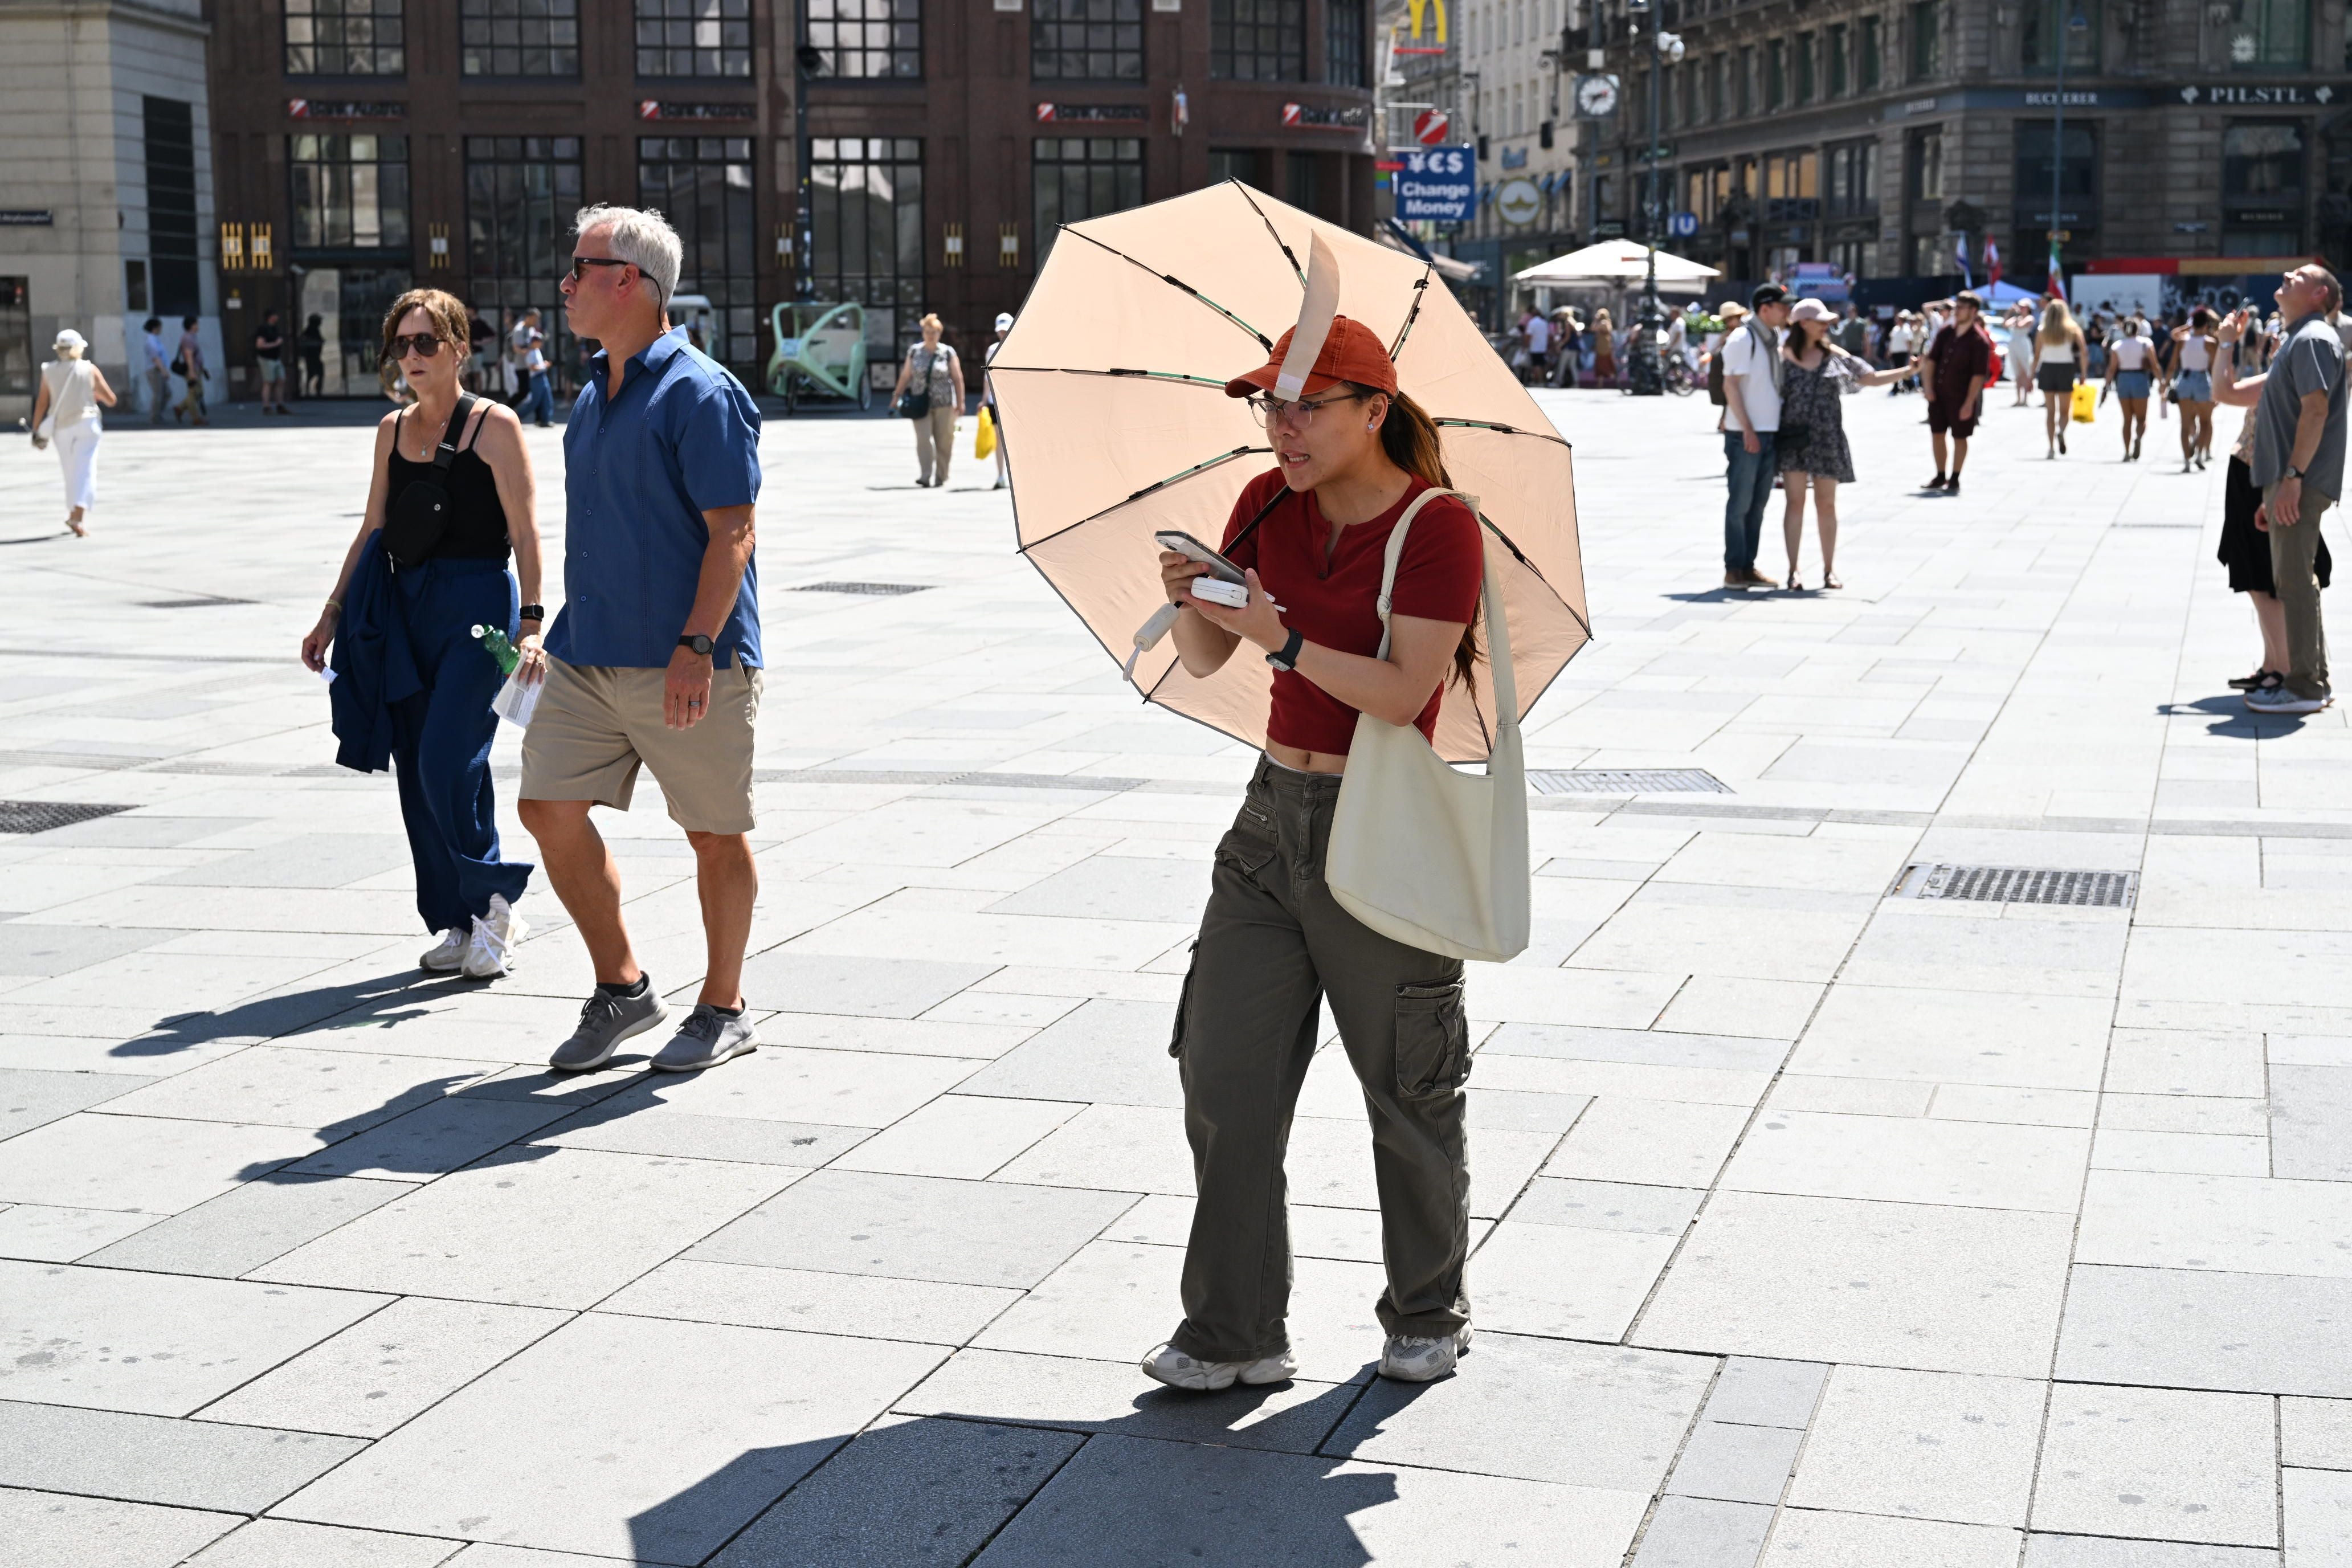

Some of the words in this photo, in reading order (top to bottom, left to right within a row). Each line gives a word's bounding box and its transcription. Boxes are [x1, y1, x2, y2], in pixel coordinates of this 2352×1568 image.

[2210, 87, 2305, 103] PILSTL
[1401, 181, 1471, 200] Change
[1405, 199, 1465, 218] Money
[1678, 215, 1696, 235] U
